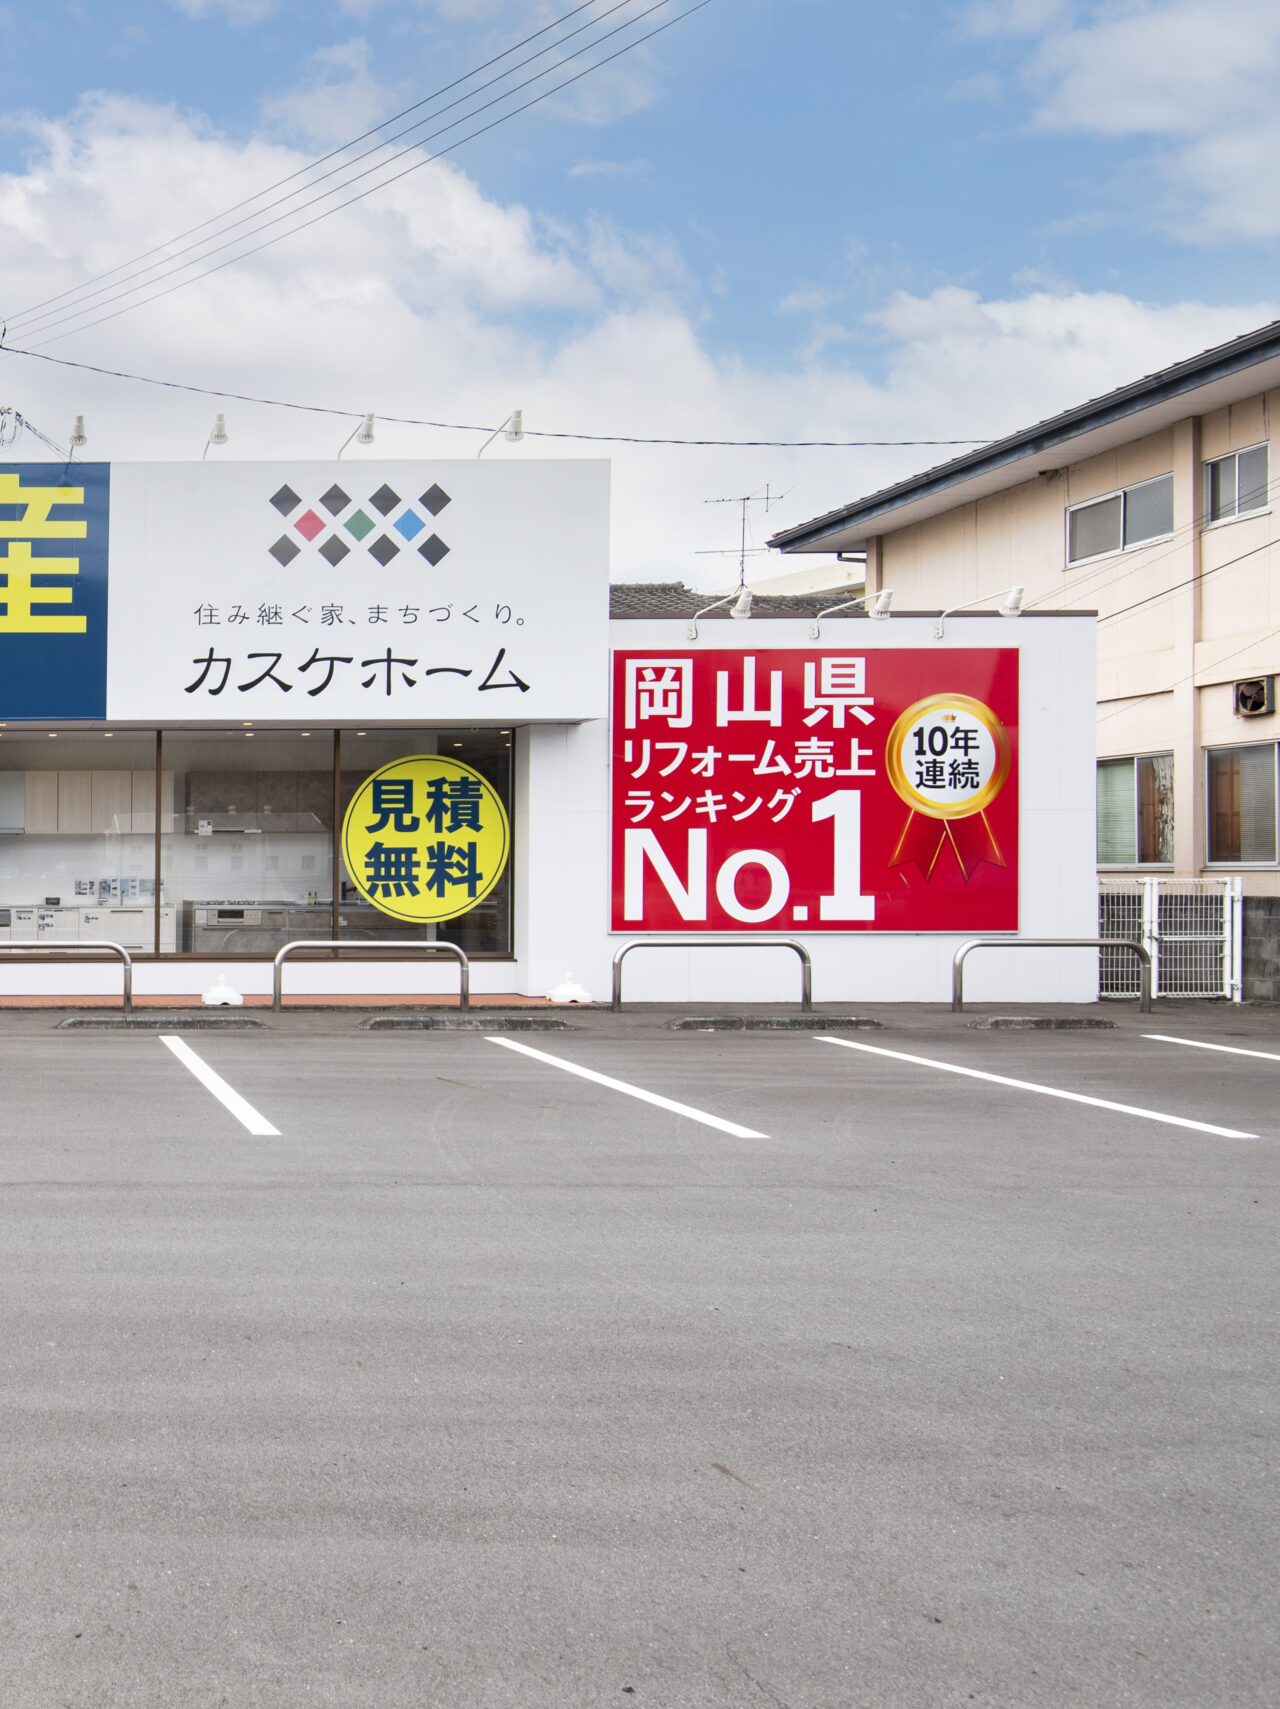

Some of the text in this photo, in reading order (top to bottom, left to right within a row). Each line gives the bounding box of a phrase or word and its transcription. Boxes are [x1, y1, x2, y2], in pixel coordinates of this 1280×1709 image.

[194, 603, 525, 626] 住み継ぐ家、まちづくり。
[184, 647, 531, 697] カスケホーム
[624, 656, 876, 730] 岡山県
[624, 736, 876, 779] リフォーム売上
[913, 726, 980, 757] 10年
[915, 758, 980, 790] 連続
[365, 776, 484, 834] 見積
[624, 786, 802, 823] ランキング
[364, 841, 484, 899] 無料
[624, 789, 876, 923] No.1
